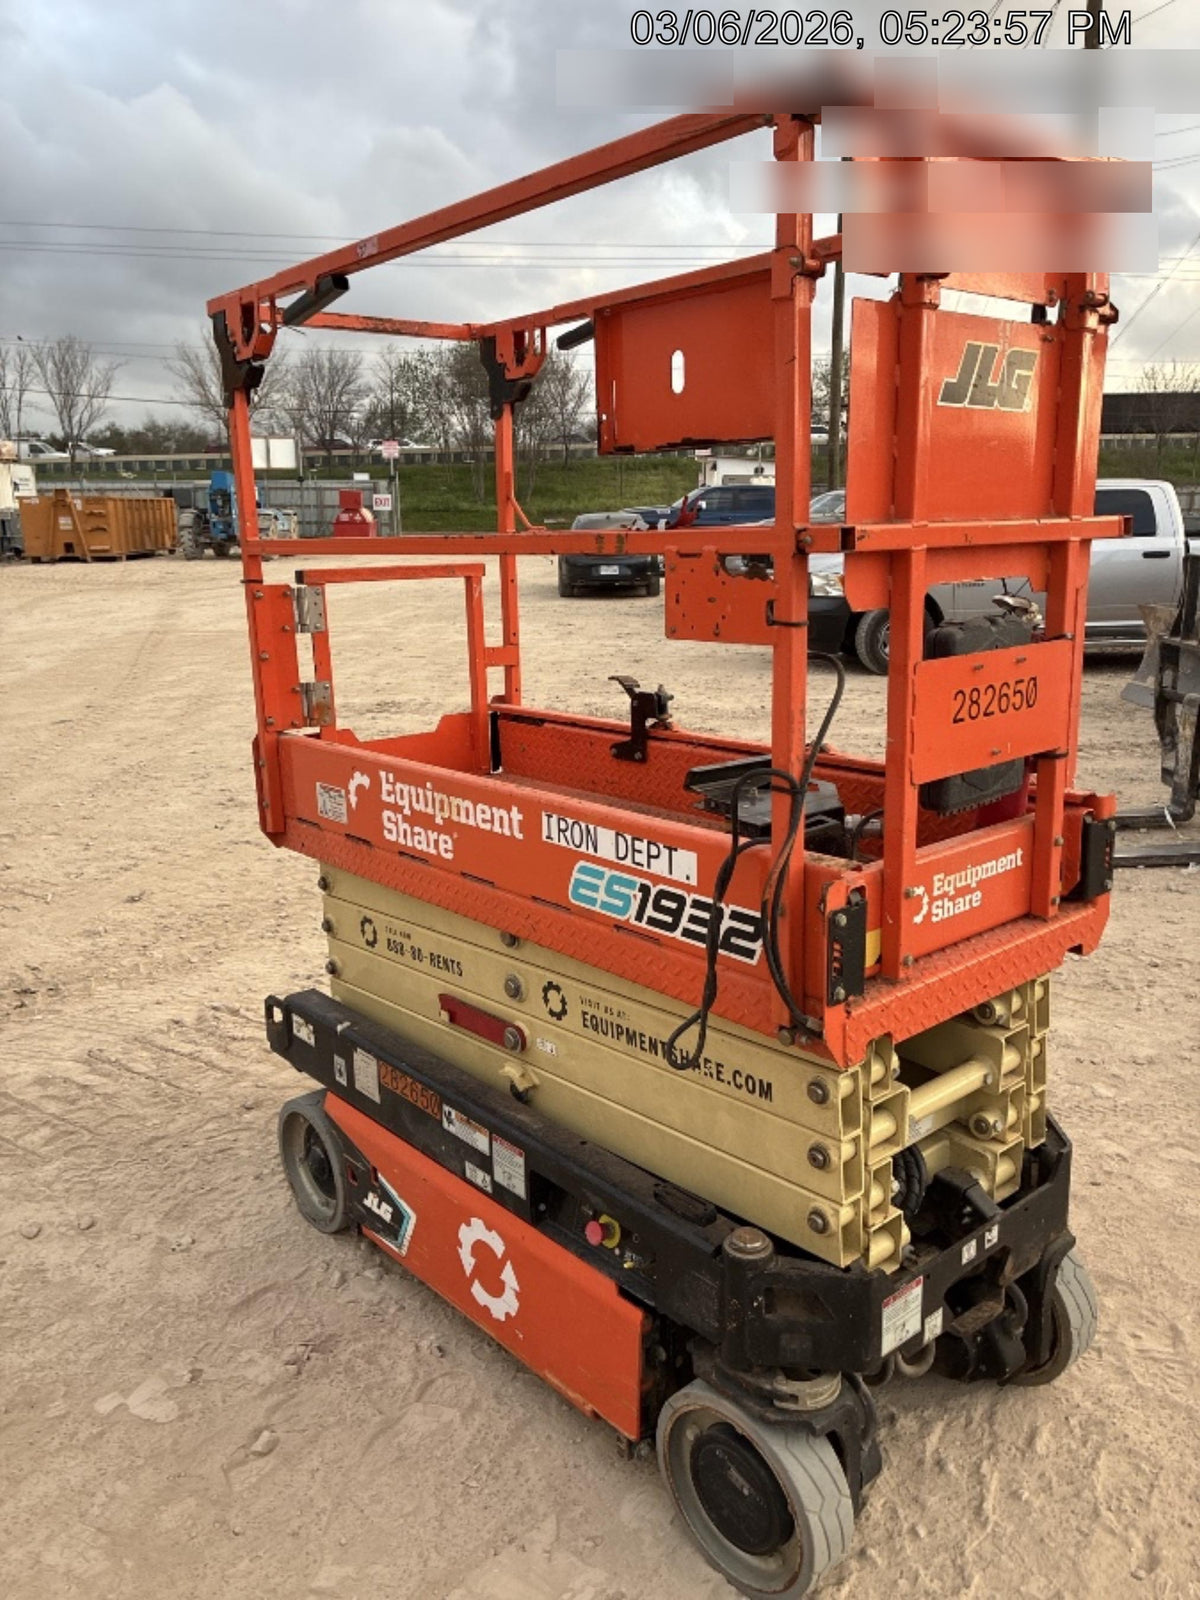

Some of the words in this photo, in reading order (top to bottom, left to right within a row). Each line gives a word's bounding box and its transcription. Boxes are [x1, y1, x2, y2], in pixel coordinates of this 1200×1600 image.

[937, 340, 1041, 412] JLG
[952, 676, 1038, 724] 282650
[378, 769, 524, 840] Equipment
[544, 813, 598, 854] IRON
[614, 831, 692, 881] DEPT.
[932, 848, 1023, 897] Equipment
[570, 863, 763, 964] ES1932
[931, 889, 982, 923] Share
[362, 1191, 394, 1224] JLG
